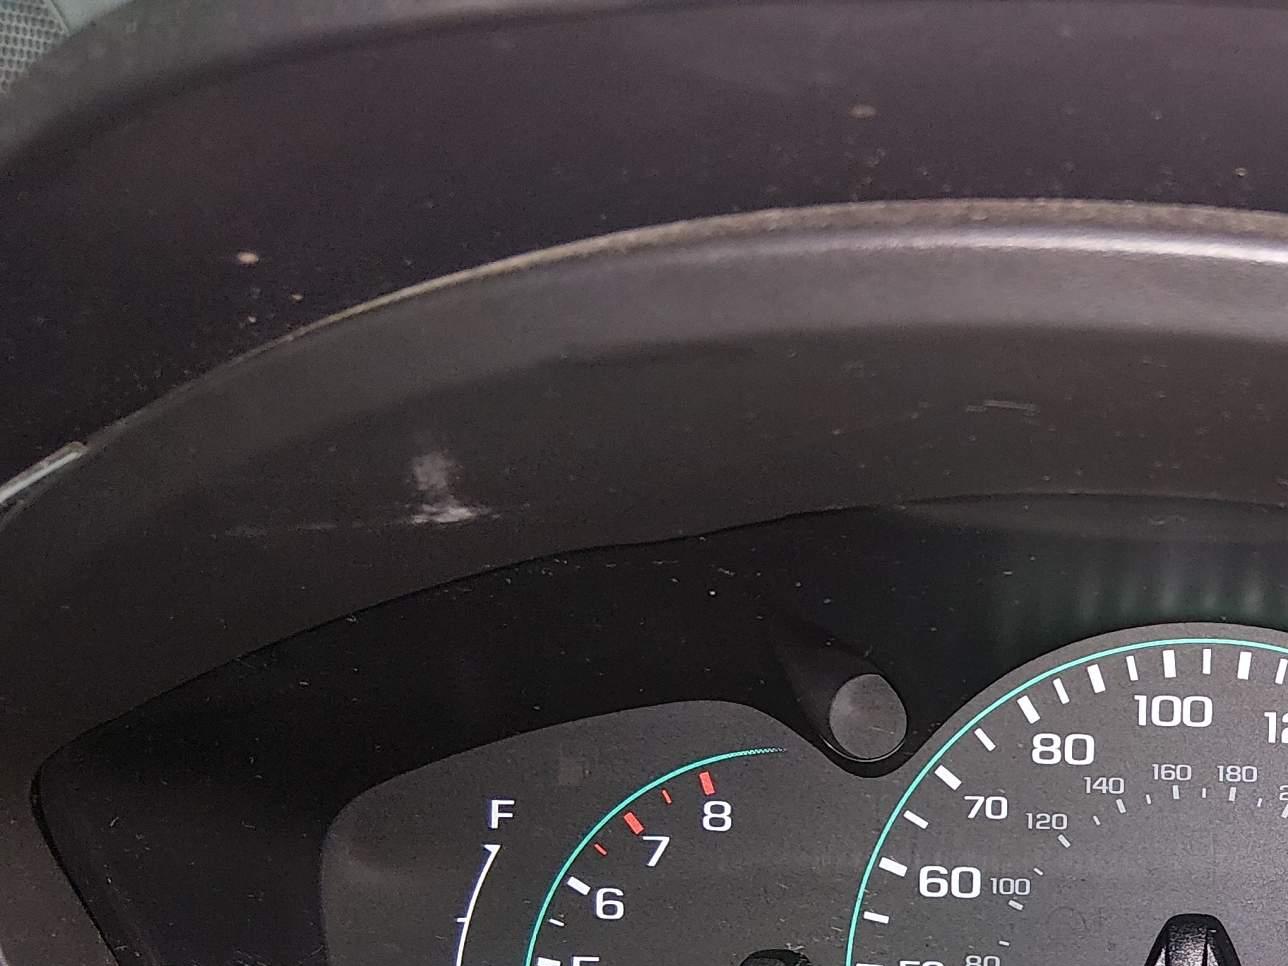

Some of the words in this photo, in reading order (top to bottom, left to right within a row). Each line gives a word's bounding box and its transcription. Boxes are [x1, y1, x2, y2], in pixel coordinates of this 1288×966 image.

[1135, 695, 1212, 727] 100
[1032, 734, 1094, 765] 80
[1084, 777, 1124, 794] 140
[1152, 764, 1191, 780] 160
[1217, 766, 1257, 782] 180
[491, 800, 514, 828] F
[703, 801, 731, 831] 8
[964, 796, 1007, 819] 70
[1026, 813, 1067, 829] 120
[643, 836, 669, 866] 7
[920, 866, 981, 898] 60
[990, 878, 1030, 895] 100
[596, 888, 624, 919] 6
